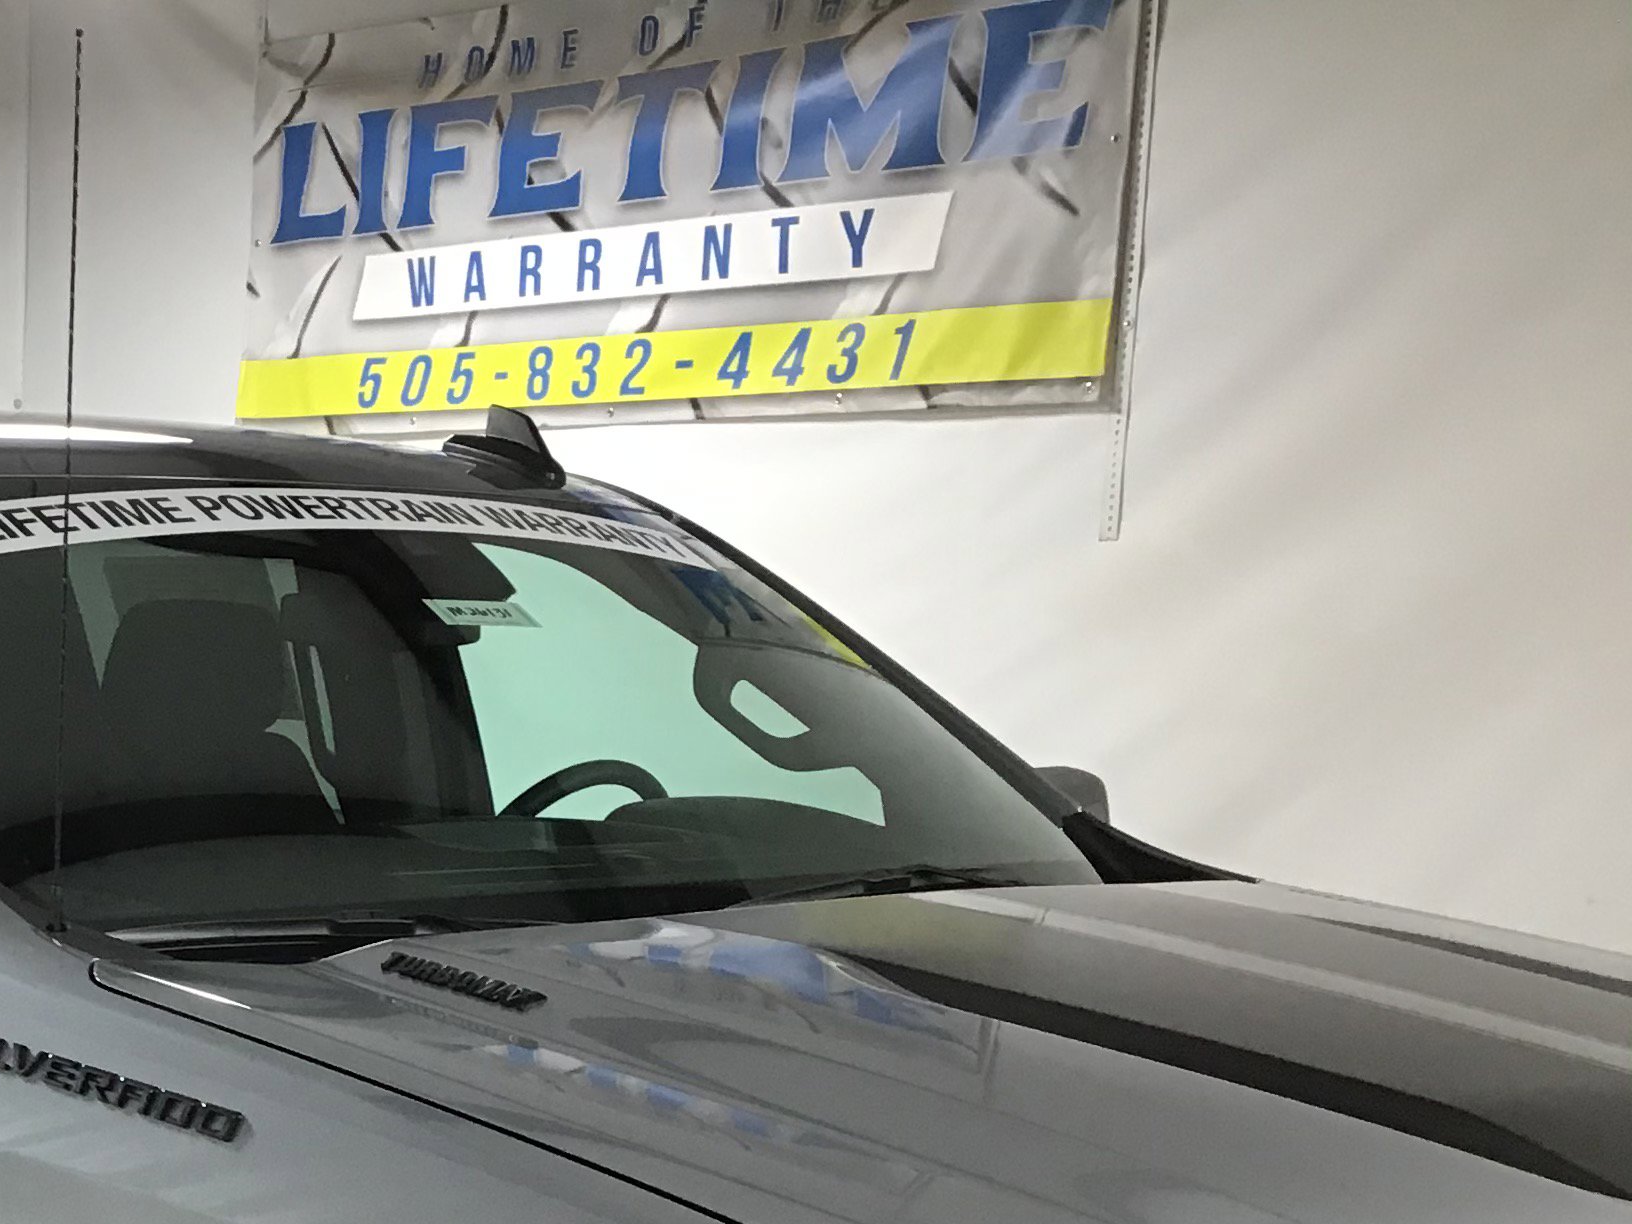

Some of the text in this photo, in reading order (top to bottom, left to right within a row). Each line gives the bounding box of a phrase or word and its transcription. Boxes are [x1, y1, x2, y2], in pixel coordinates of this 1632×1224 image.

[416, 27, 580, 89] HOME
[638, 5, 706, 57] OF
[269, 0, 1111, 246] LIFETIME
[406, 207, 876, 309] WARRANTY
[357, 318, 919, 409] 505-832-4431
[185, 494, 485, 527] POWERTRAIN
[472, 505, 688, 558] WARRANTY
